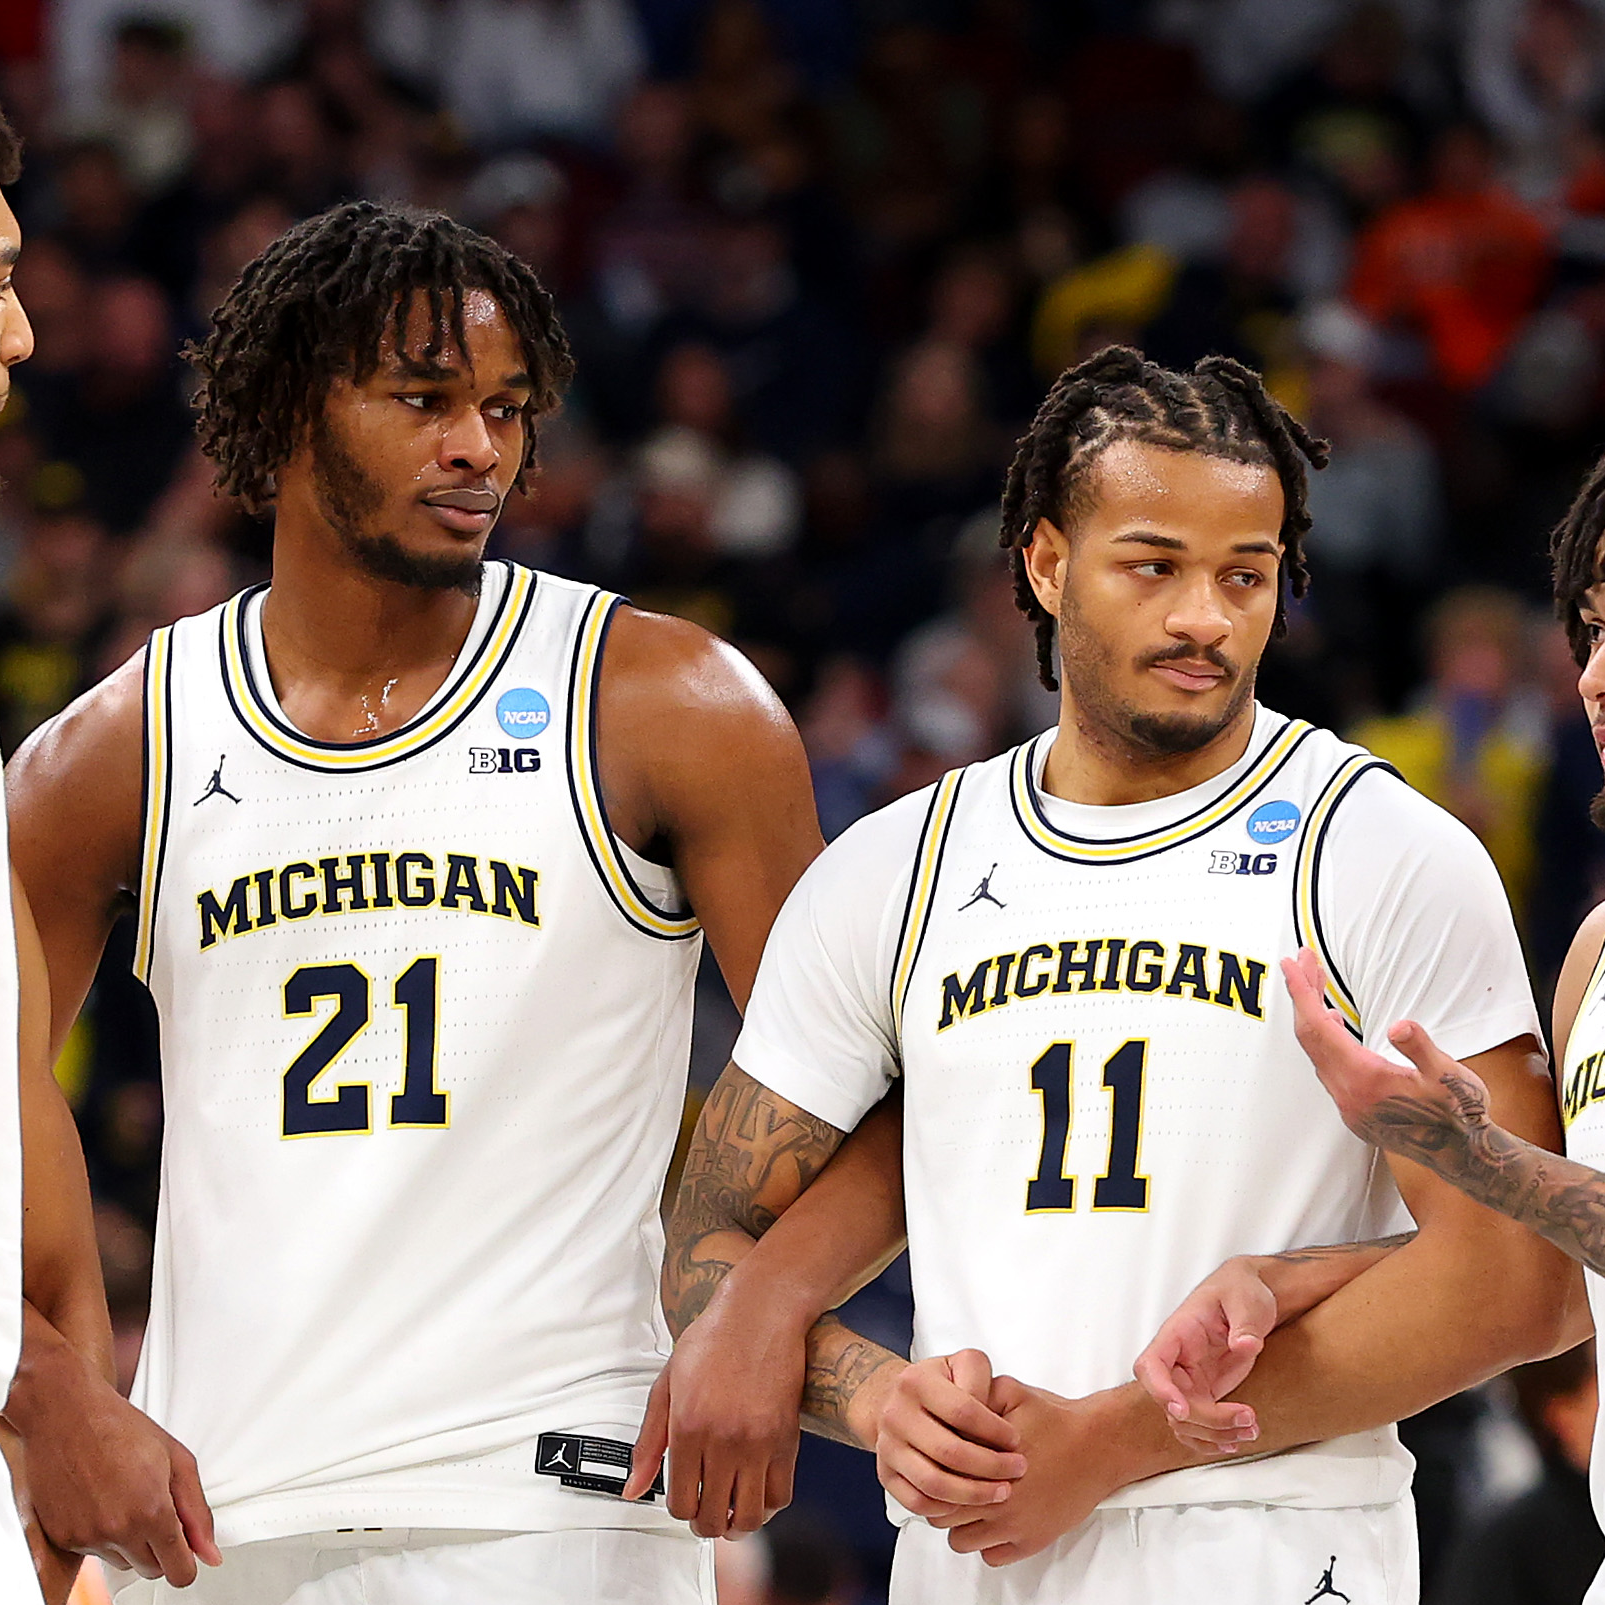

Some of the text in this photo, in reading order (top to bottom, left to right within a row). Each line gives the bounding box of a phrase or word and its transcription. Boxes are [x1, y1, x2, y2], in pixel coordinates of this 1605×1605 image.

[503, 710, 547, 725] NCAA
[1252, 817, 1297, 834] NCAA
[194, 851, 542, 954] MICHIGAN
[936, 936, 1270, 1034] MICHIGAN
[279, 953, 451, 1141] 21
[1024, 1036, 1151, 1216] 11
